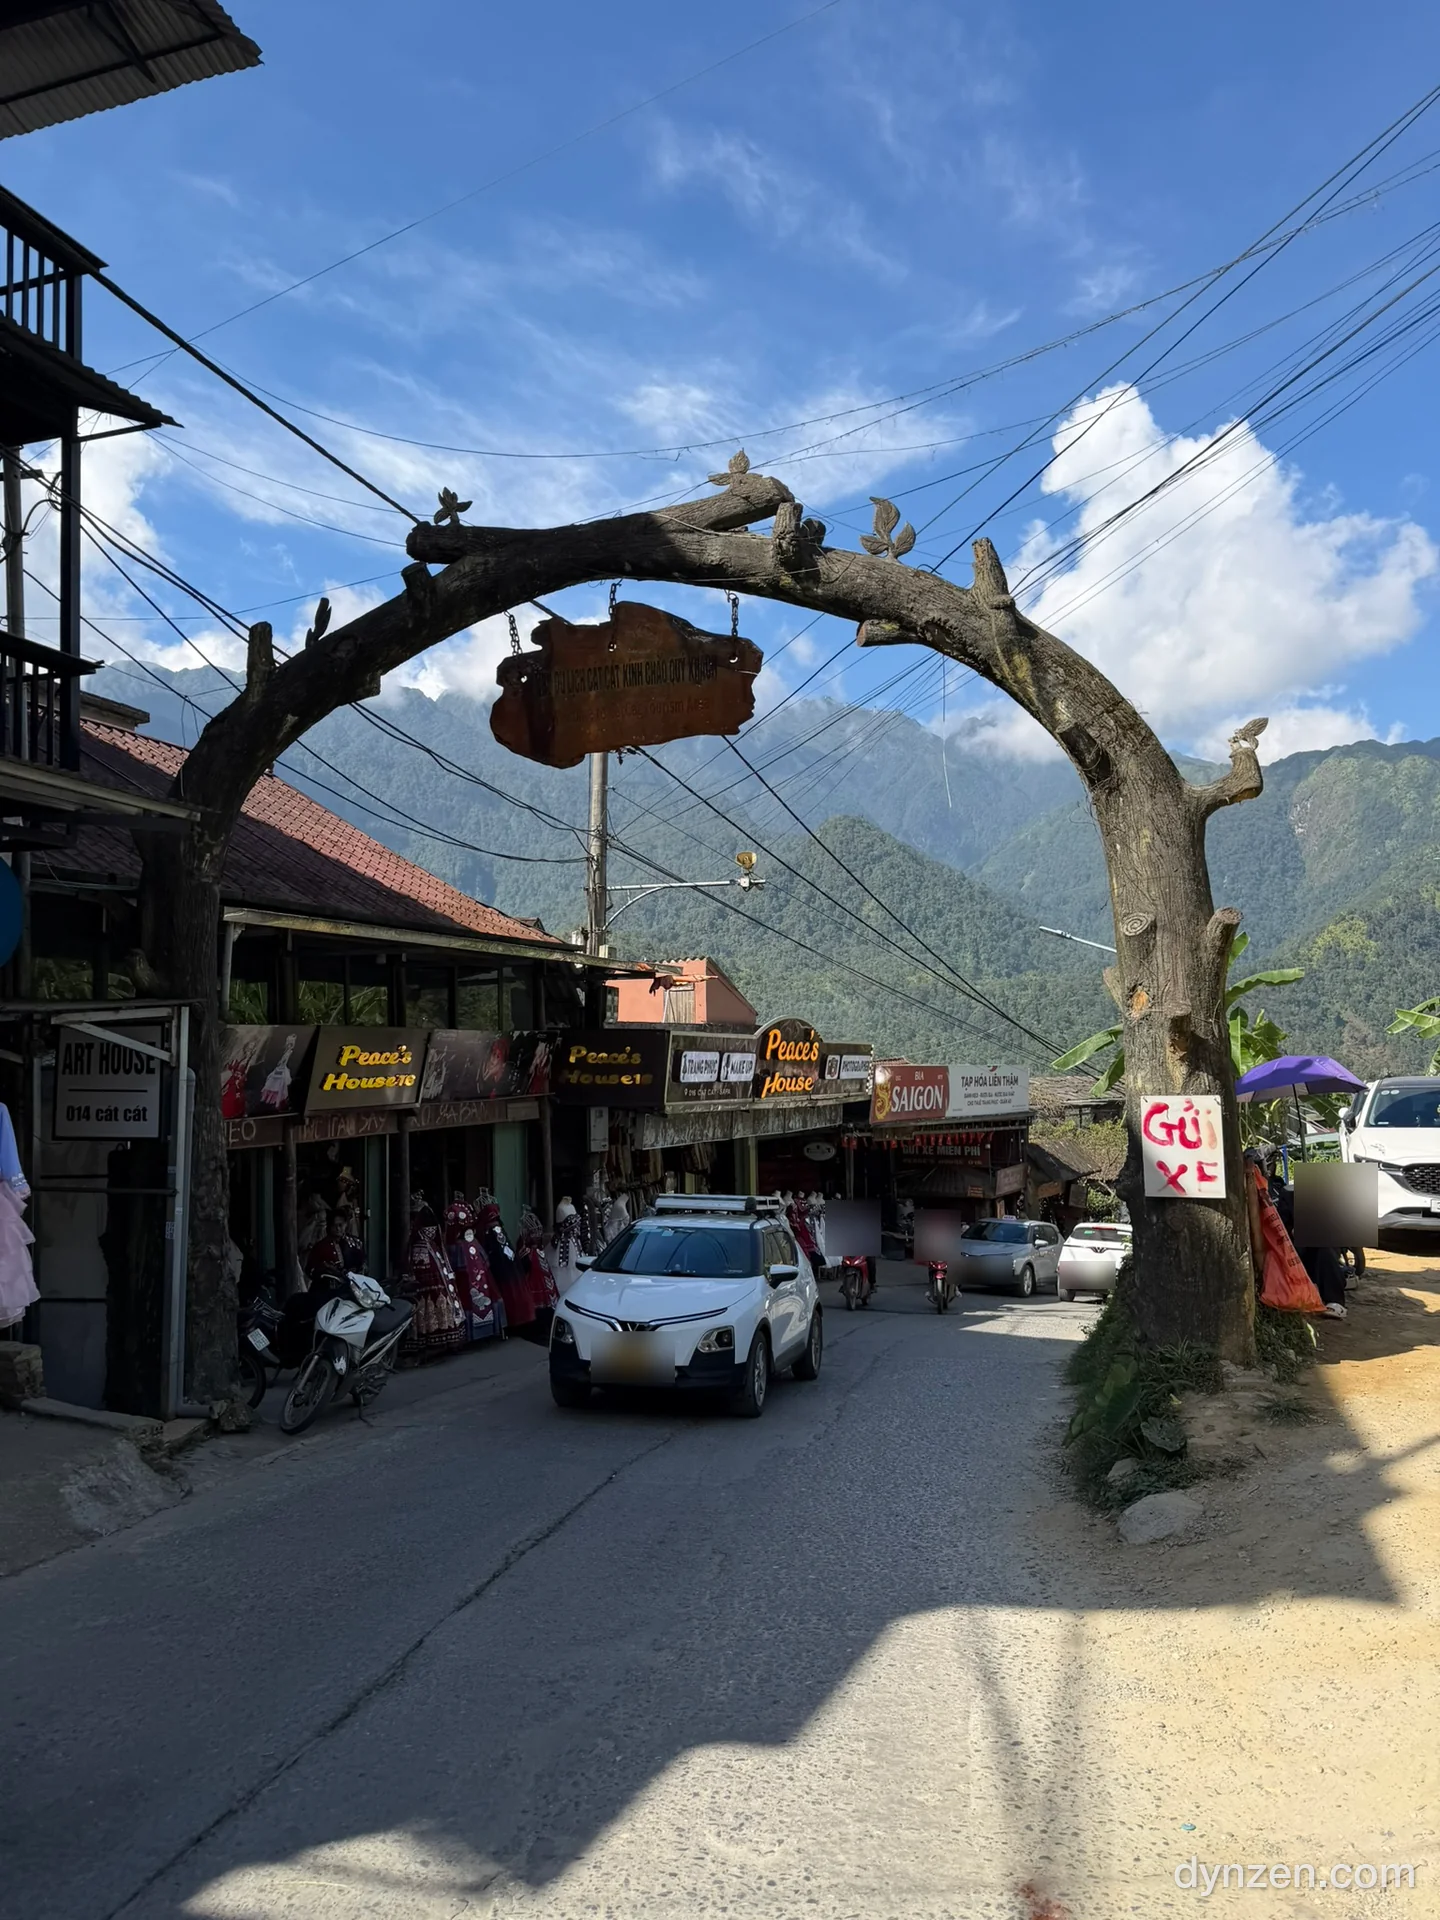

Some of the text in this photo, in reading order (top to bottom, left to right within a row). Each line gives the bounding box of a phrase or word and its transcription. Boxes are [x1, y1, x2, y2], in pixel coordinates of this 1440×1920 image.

[622, 658, 643, 688] KÍNH
[645, 655, 667, 685] CHÀO
[339, 1044, 412, 1066] Peace's
[568, 1045, 642, 1064] Peace's
[765, 1028, 820, 1061] Peace's
[62, 1042, 156, 1075] ART HOUSE
[730, 1060, 753, 1075] MAKE UP
[760, 1071, 814, 1099] House
[914, 1071, 924, 1081] BIA
[961, 1076, 973, 1091] TẠP
[974, 1073, 987, 1087] HÓA
[891, 1085, 944, 1112] SAIGON
[67, 1104, 147, 1121] 014 cát cát
[922, 1145, 934, 1155] XE
[1156, 1160, 1218, 1194] XE
